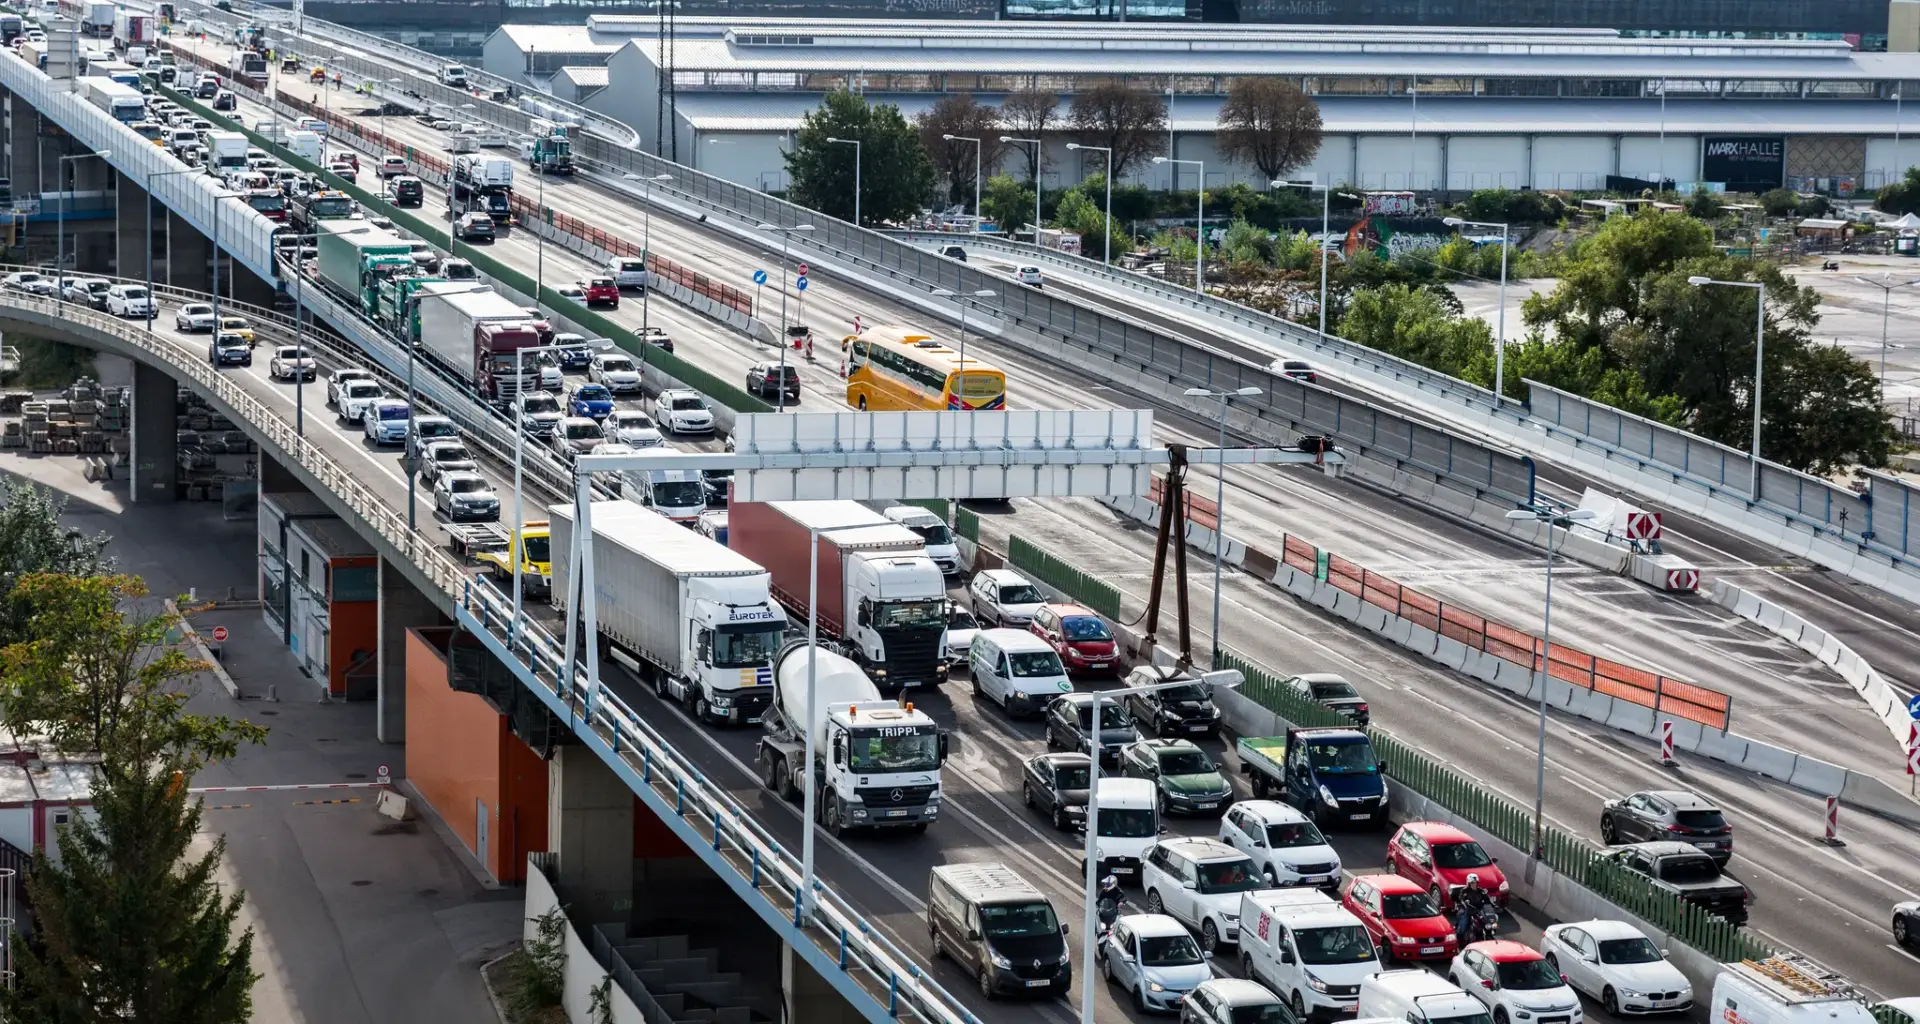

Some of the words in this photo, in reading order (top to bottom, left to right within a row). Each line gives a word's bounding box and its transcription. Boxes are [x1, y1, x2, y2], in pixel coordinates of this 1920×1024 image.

[1289, 0, 1332, 14] Mobile
[729, 612, 774, 620] EUROTEK
[877, 726, 920, 737] TRIPPL
